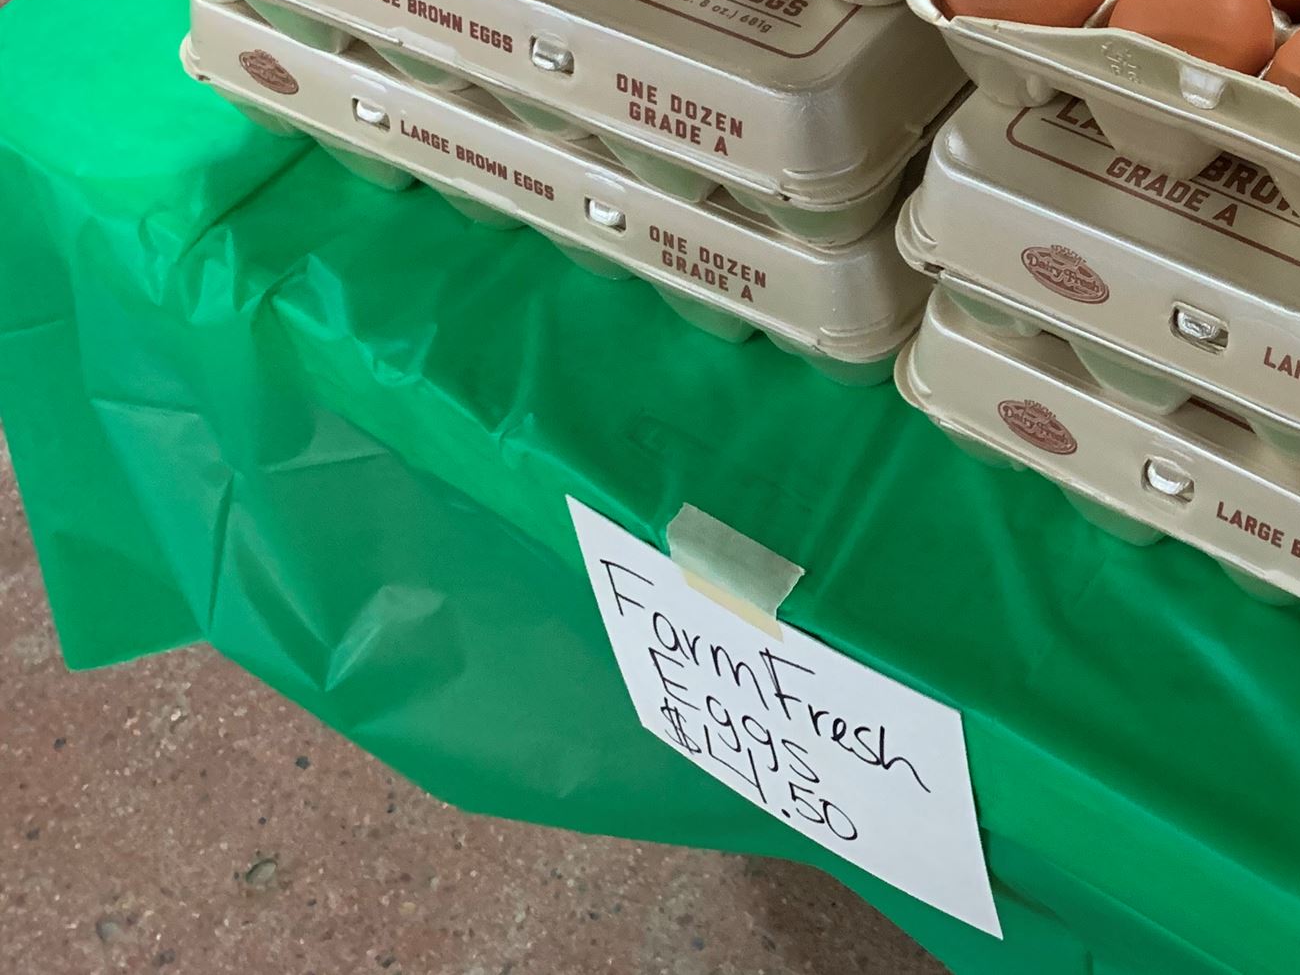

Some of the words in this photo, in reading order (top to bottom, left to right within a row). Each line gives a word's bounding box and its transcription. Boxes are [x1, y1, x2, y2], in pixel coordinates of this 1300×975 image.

[469, 20, 514, 54] EGGS
[738, 13, 773, 34] 681g
[616, 73, 658, 106] ONE
[670, 93, 743, 139] DOZEN
[629, 101, 701, 146] GRADE
[714, 135, 729, 157] A
[400, 120, 451, 155] LARGE
[456, 144, 508, 181] BROWN
[513, 170, 556, 202] EGGS
[1105, 155, 1211, 213] GRADE
[1213, 203, 1241, 228] A
[649, 225, 688, 256] ONE
[699, 246, 767, 289] DOZEN
[661, 249, 730, 293] GRADE
[740, 284, 754, 304] A
[1216, 501, 1286, 549] LARGE
[648, 646, 821, 785] Eggs
[660, 697, 860, 842] $4.50
